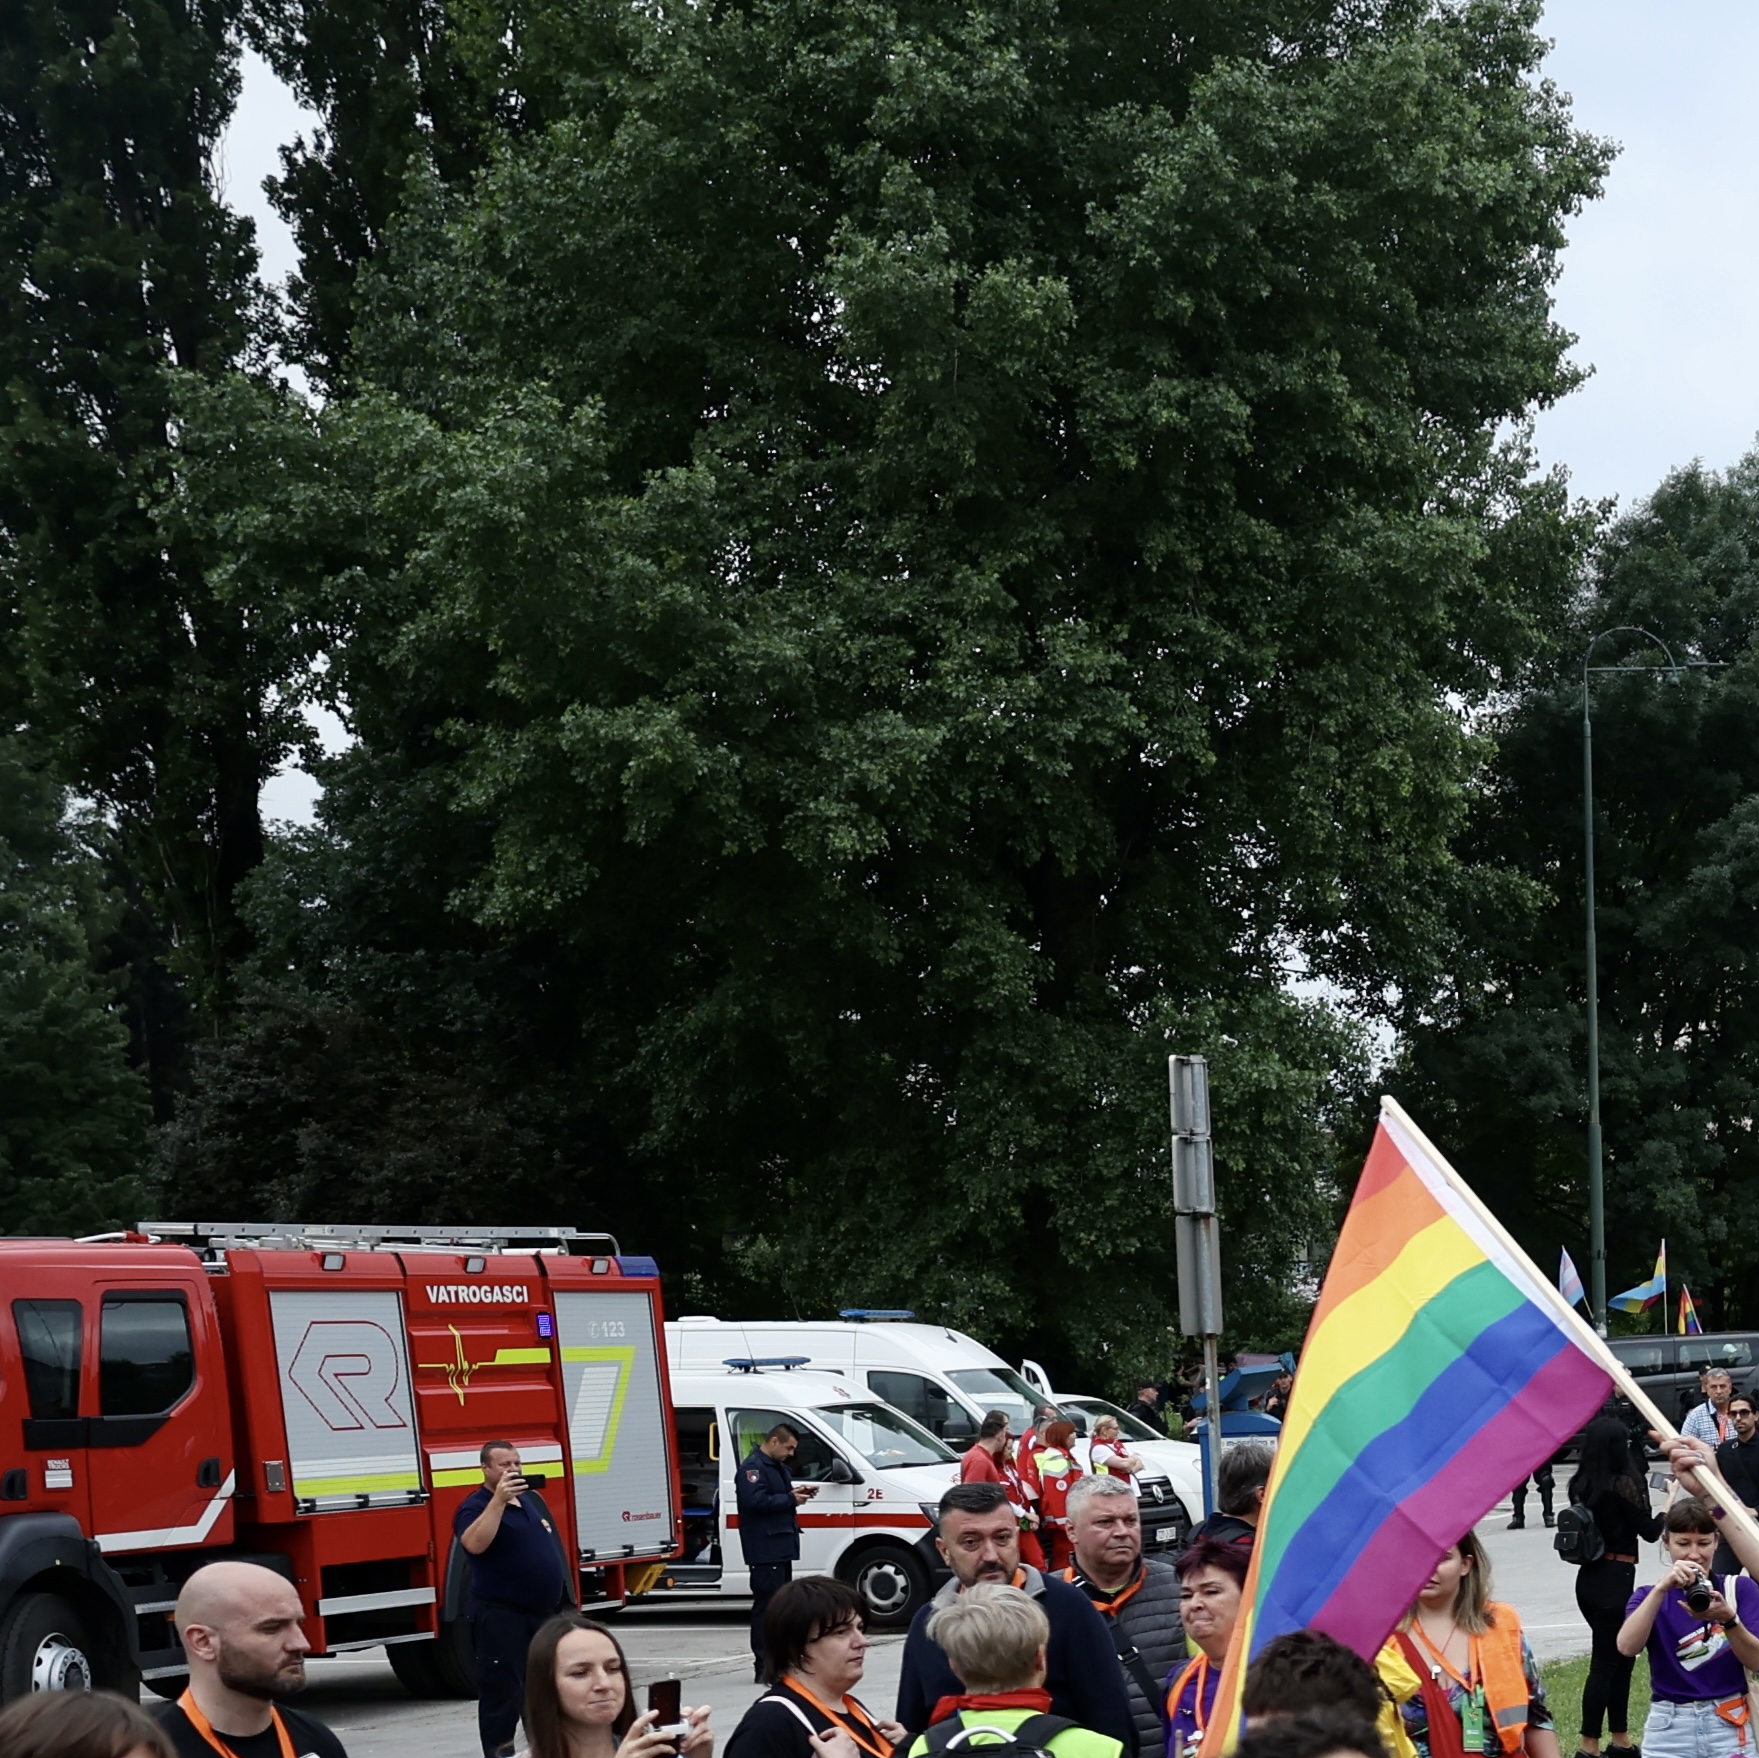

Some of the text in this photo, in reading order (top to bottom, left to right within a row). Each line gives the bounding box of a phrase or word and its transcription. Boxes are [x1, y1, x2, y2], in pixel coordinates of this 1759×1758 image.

[426, 1285, 529, 1303] VATROGASCI
[602, 1321, 626, 1338] 123
[867, 1488, 883, 1499] 2E
